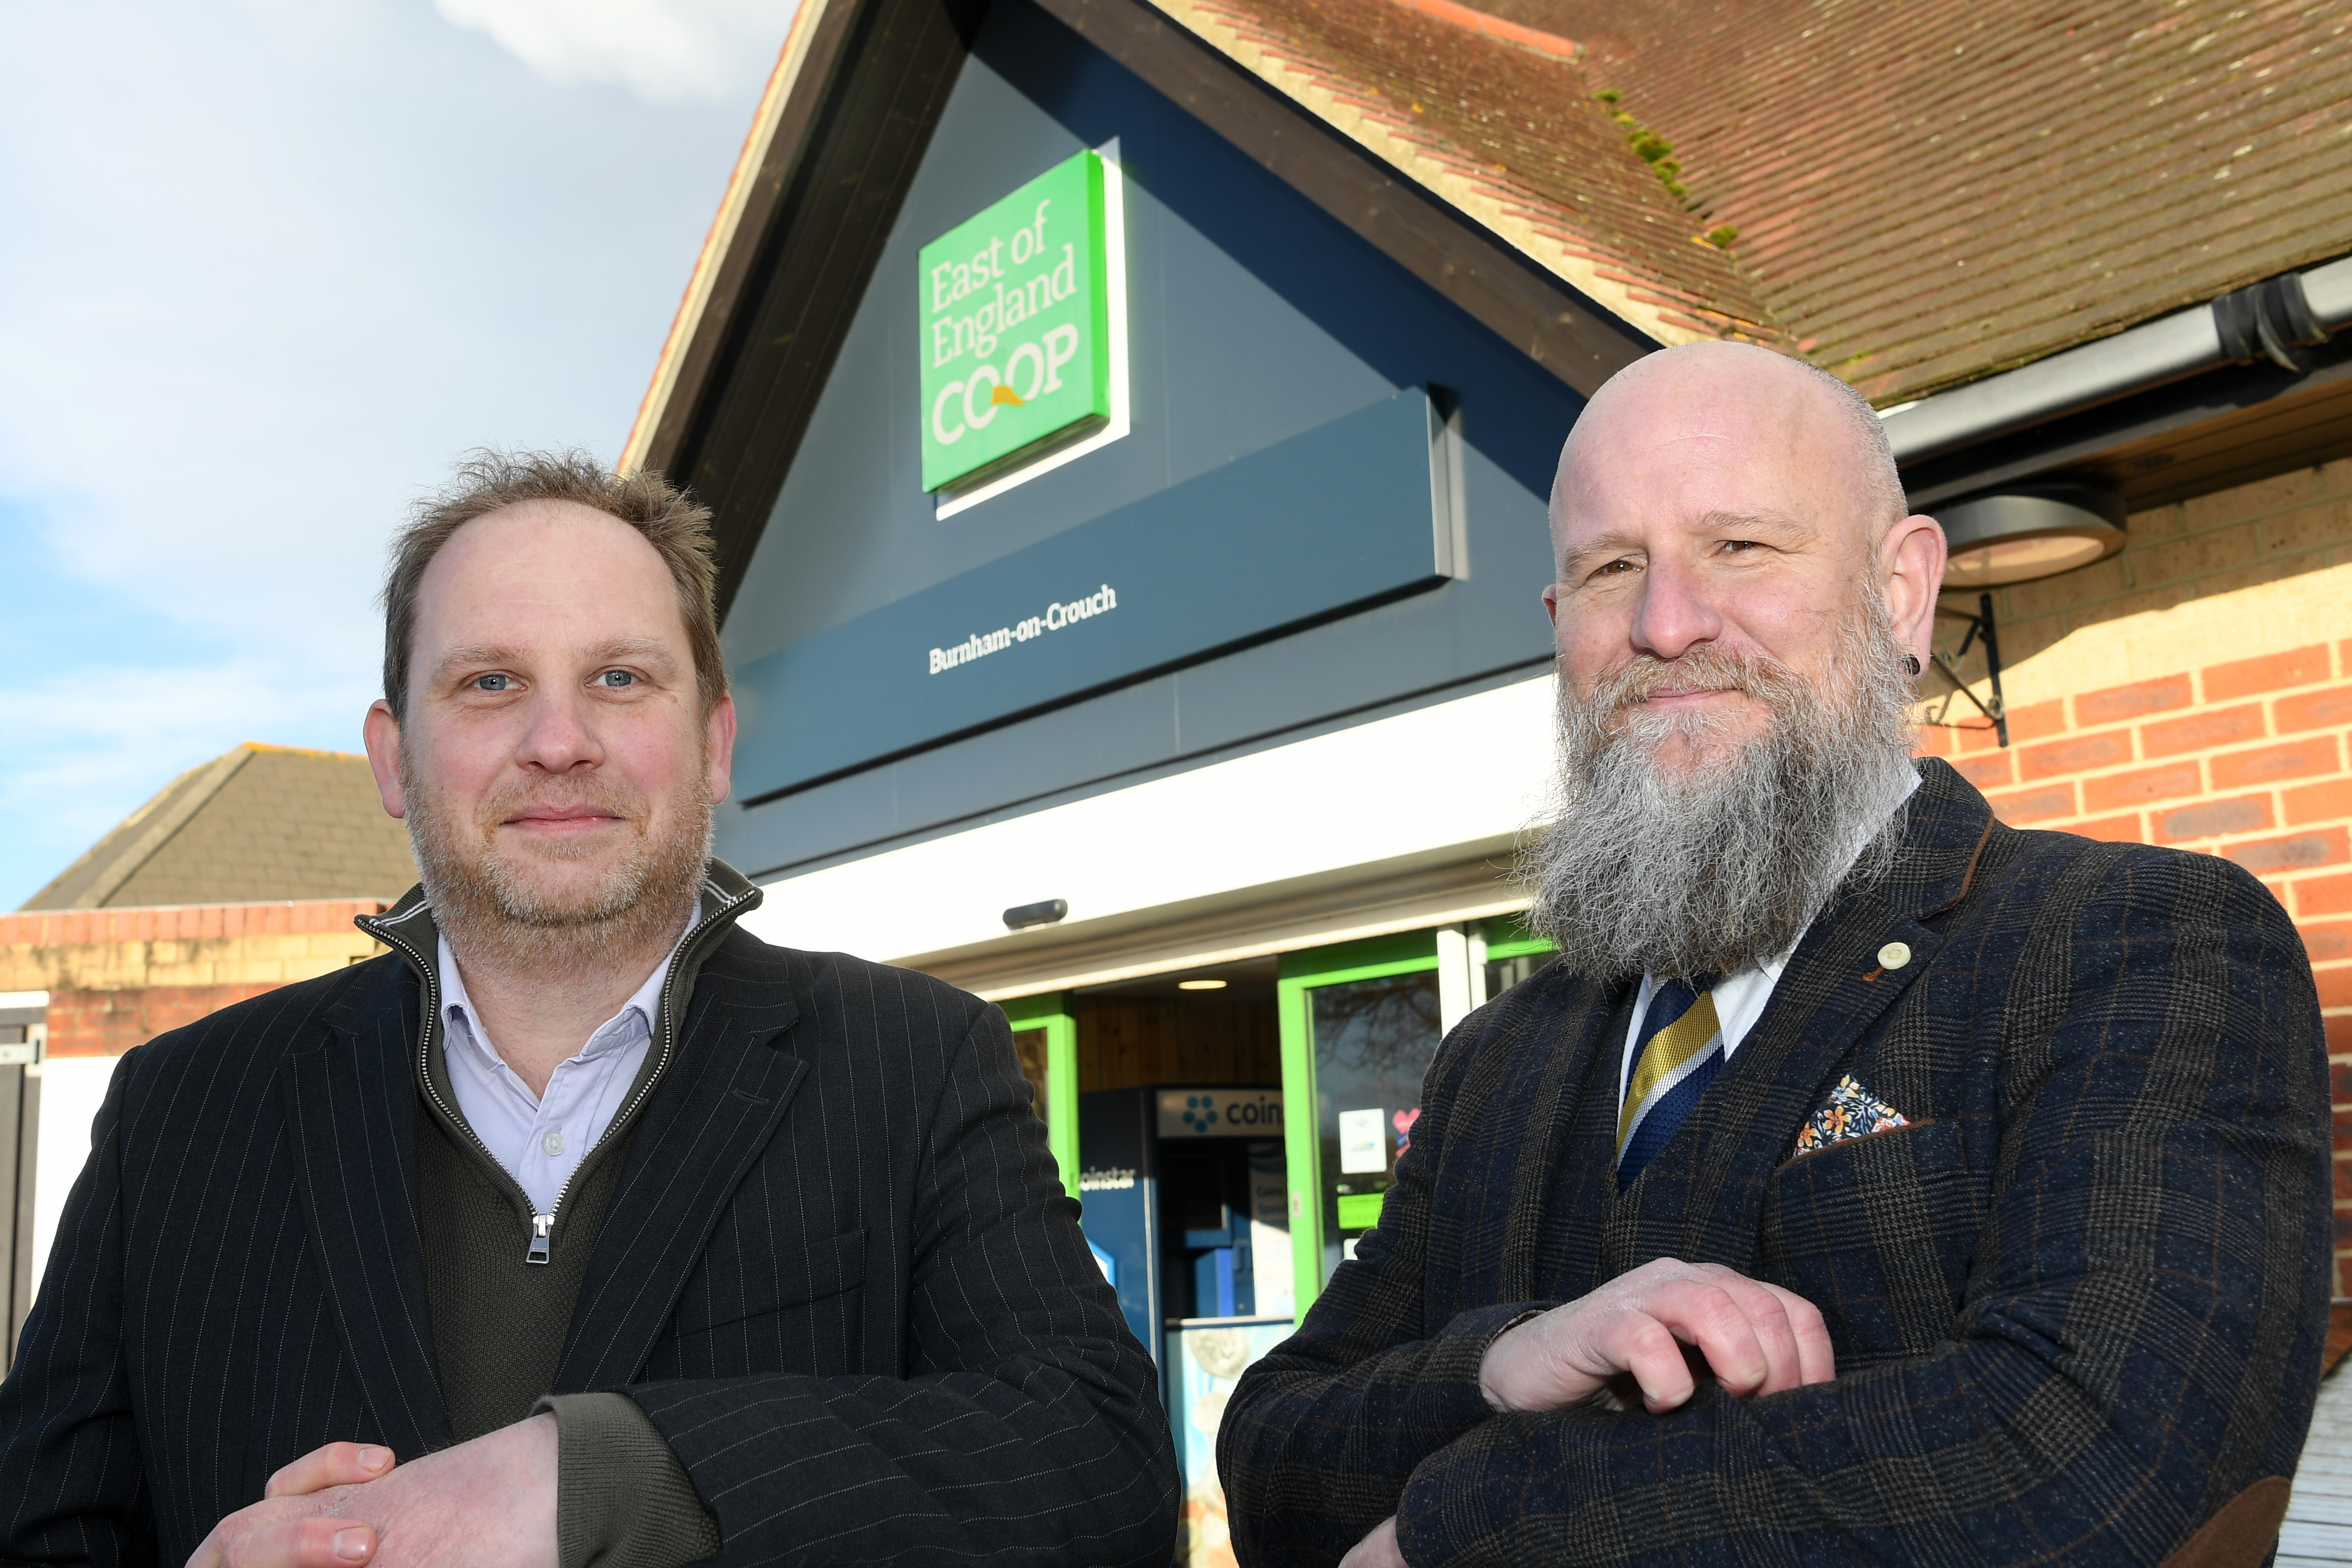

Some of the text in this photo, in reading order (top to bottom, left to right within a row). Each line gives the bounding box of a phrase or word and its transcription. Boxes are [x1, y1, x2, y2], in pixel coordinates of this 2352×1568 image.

[930, 199, 1051, 314] East of
[931, 243, 1077, 368] England
[929, 584, 1117, 675] Burnham-on-Crouch
[1226, 1096, 1282, 1125] coin
[1078, 1166, 1135, 1191] oinstar
